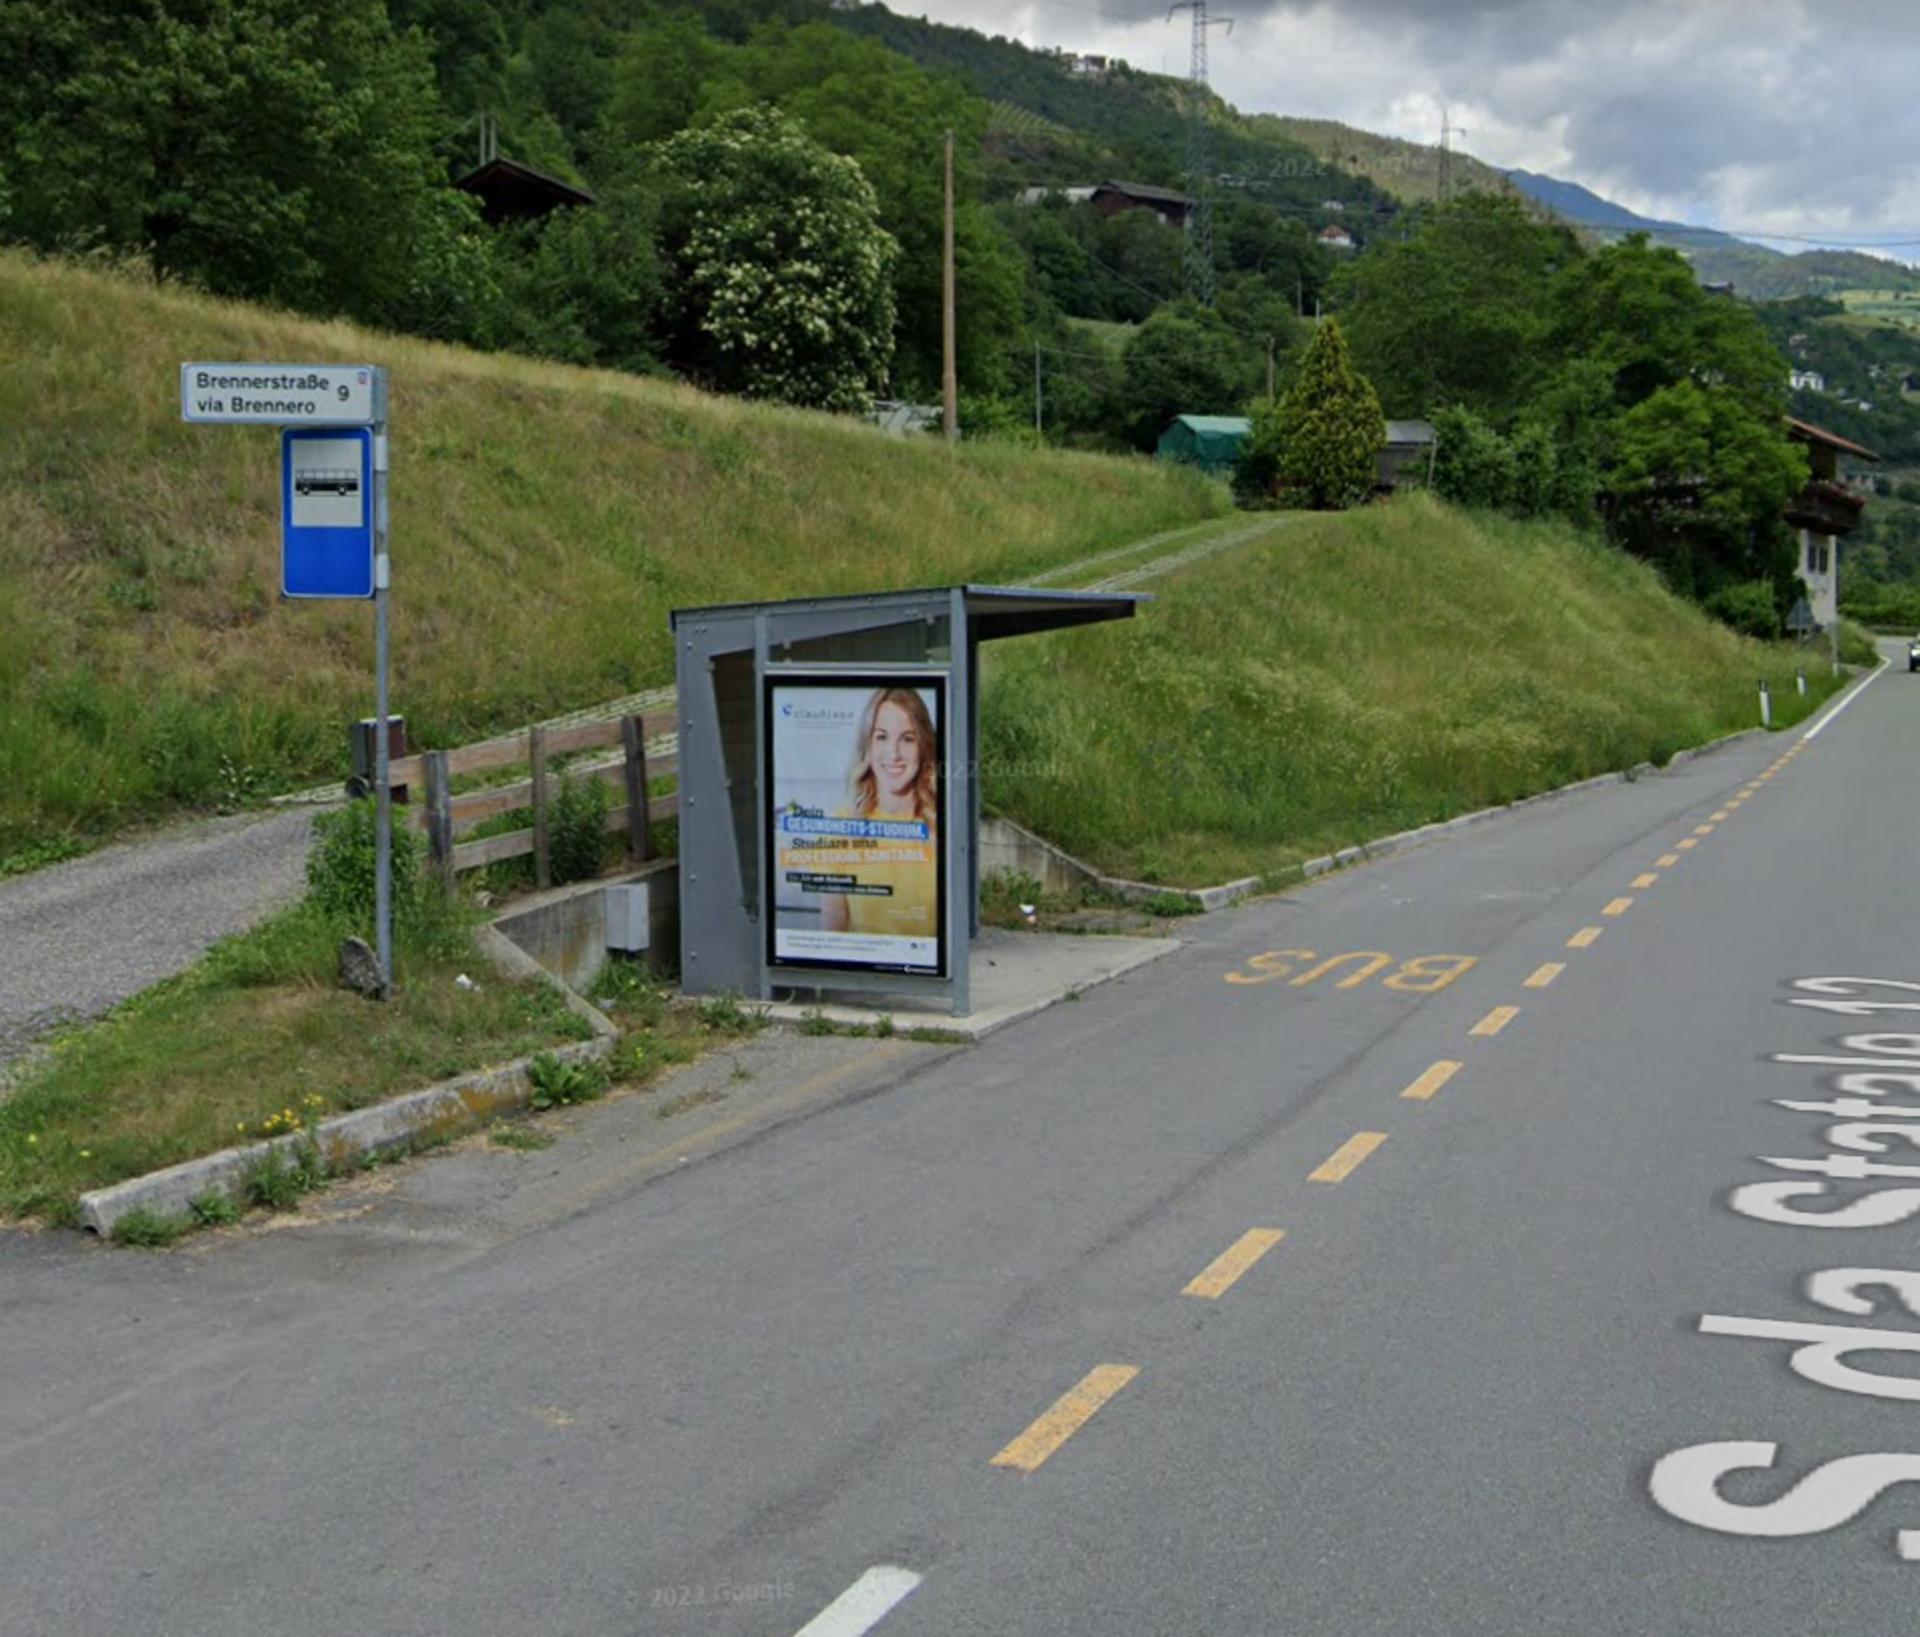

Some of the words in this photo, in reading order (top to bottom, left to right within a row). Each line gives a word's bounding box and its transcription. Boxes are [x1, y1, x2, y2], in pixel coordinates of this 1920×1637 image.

[196, 372, 330, 390] Brennerstraße
[337, 385, 350, 402] 9
[197, 396, 224, 413] via
[231, 396, 316, 414] Brennero
[794, 806, 824, 818] Dein
[792, 837, 850, 849] Studiare
[1223, 949, 1479, 992] BUS
